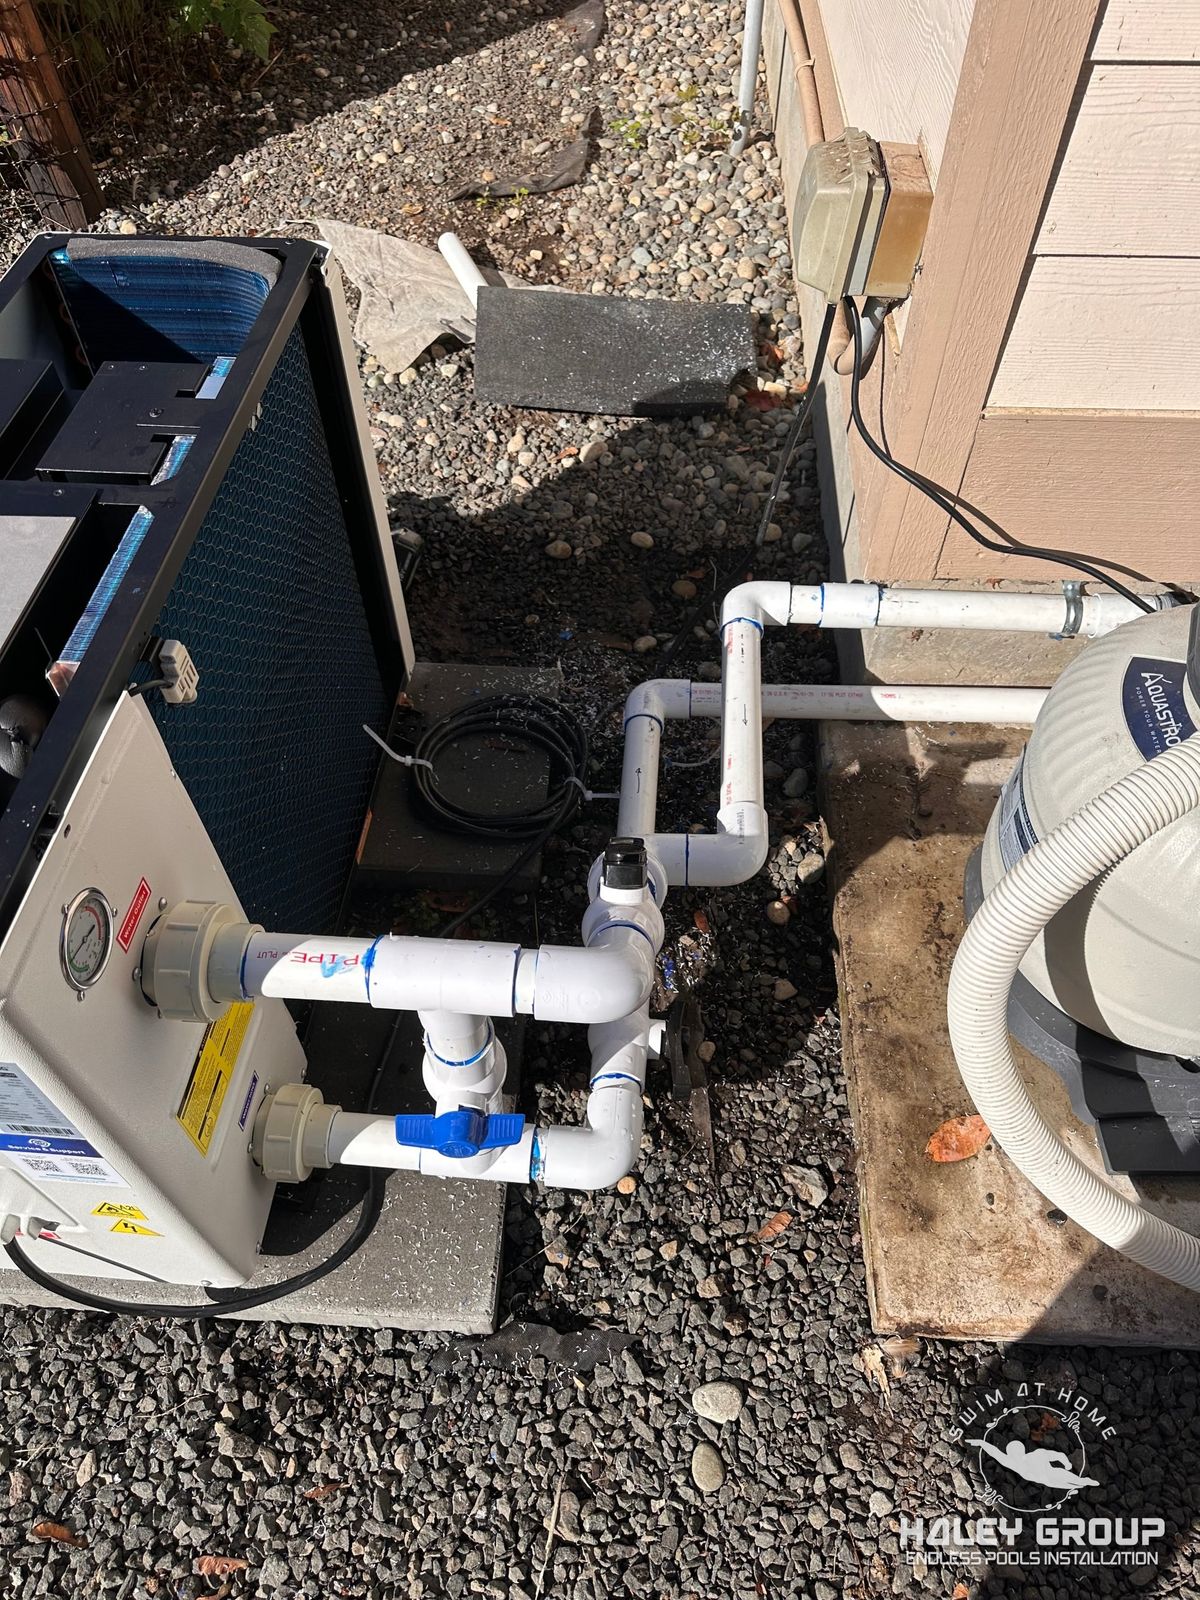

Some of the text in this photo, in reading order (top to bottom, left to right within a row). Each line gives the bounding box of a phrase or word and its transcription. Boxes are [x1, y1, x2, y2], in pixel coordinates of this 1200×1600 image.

[1136, 687, 1162, 753] POWER YOUR WATER
[123, 890, 147, 939] Water Outlet
[290, 951, 360, 966] PIPE
[49, 1147, 87, 1155] Support
